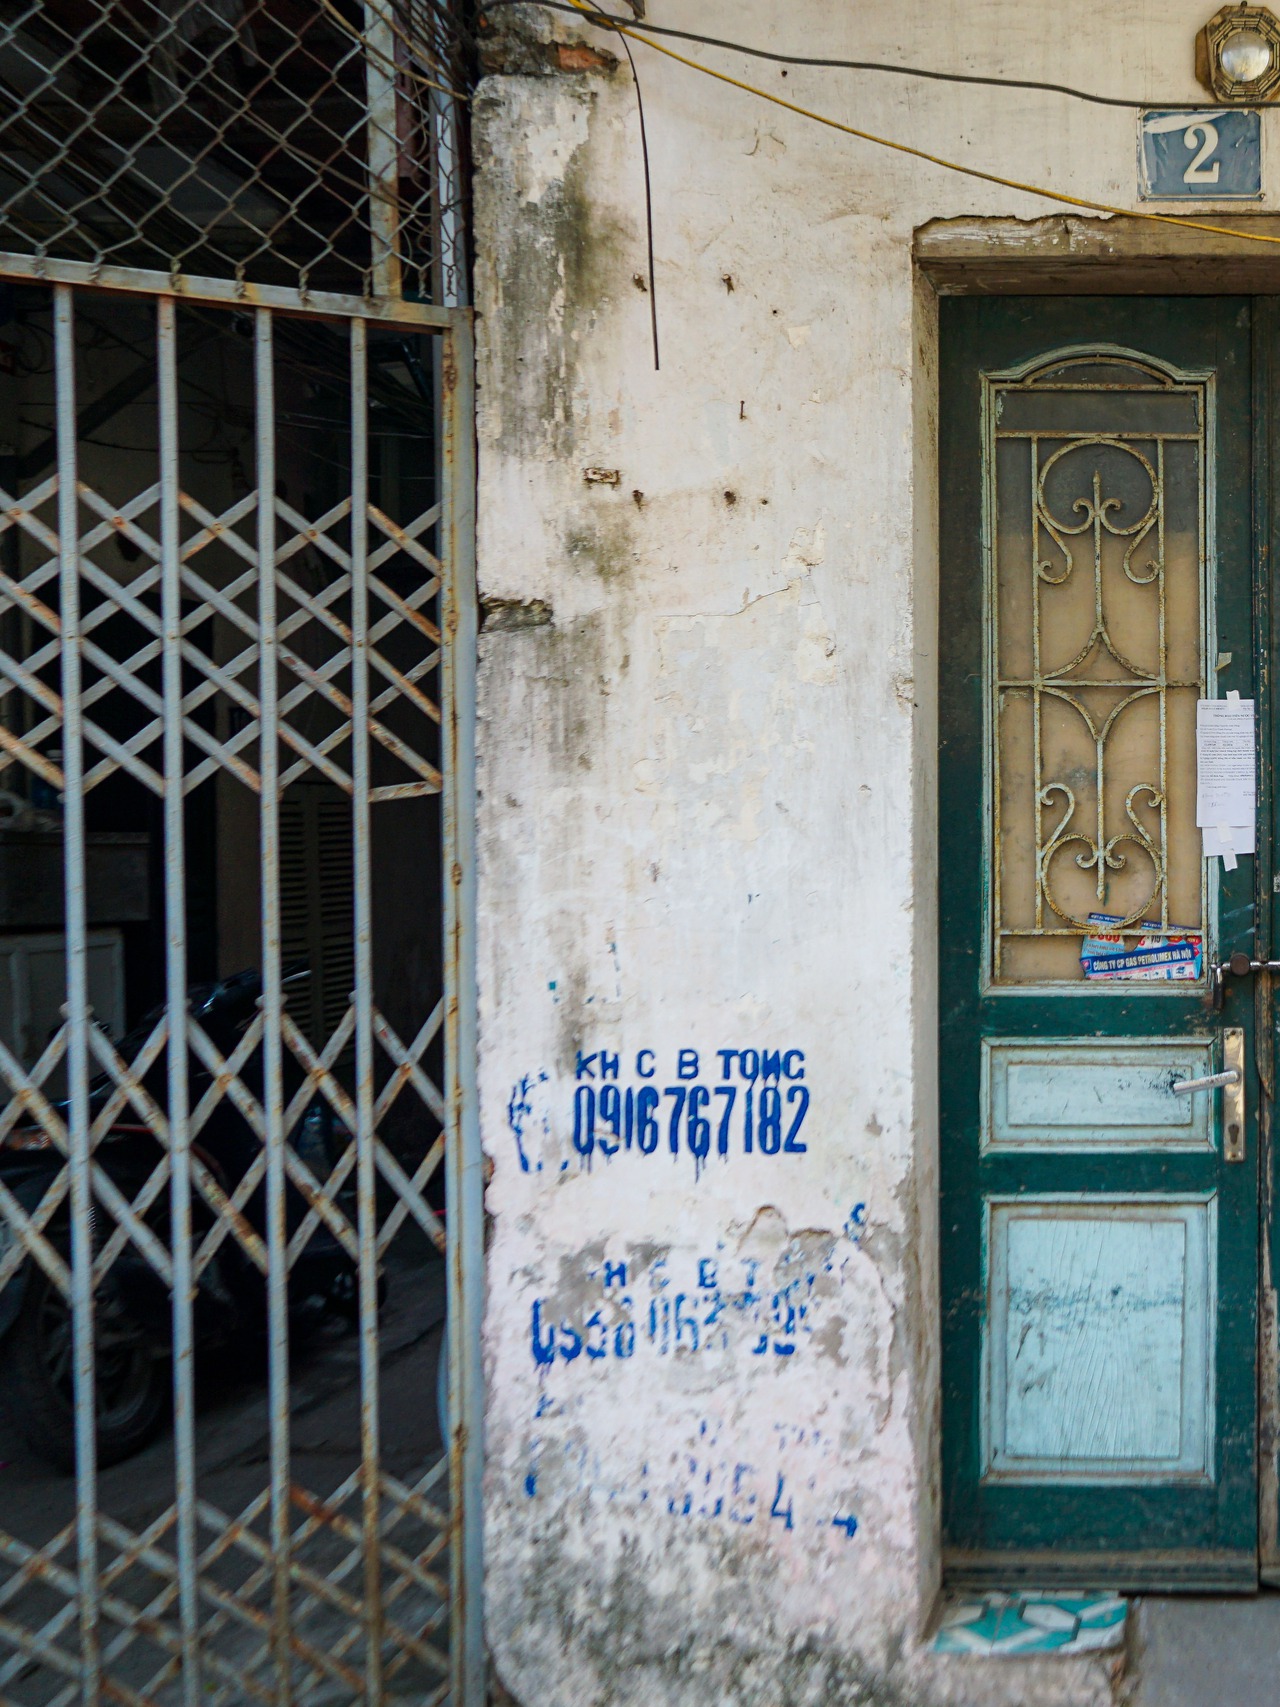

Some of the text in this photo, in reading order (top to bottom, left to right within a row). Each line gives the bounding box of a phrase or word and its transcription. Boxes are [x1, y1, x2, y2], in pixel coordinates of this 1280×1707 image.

[1184, 122, 1220, 184] 2
[1093, 959, 1108, 971] CÔNG
[1109, 960, 1116, 969] TY
[1116, 959, 1125, 969] CP
[1126, 956, 1138, 968] GAS
[1138, 951, 1172, 965] PETROLIMEX
[1172, 949, 1181, 960] HÀ
[576, 1050, 619, 1080] KH
[636, 1049, 656, 1078] C
[678, 1049, 700, 1080] B
[573, 1085, 811, 1155] 0916767182
